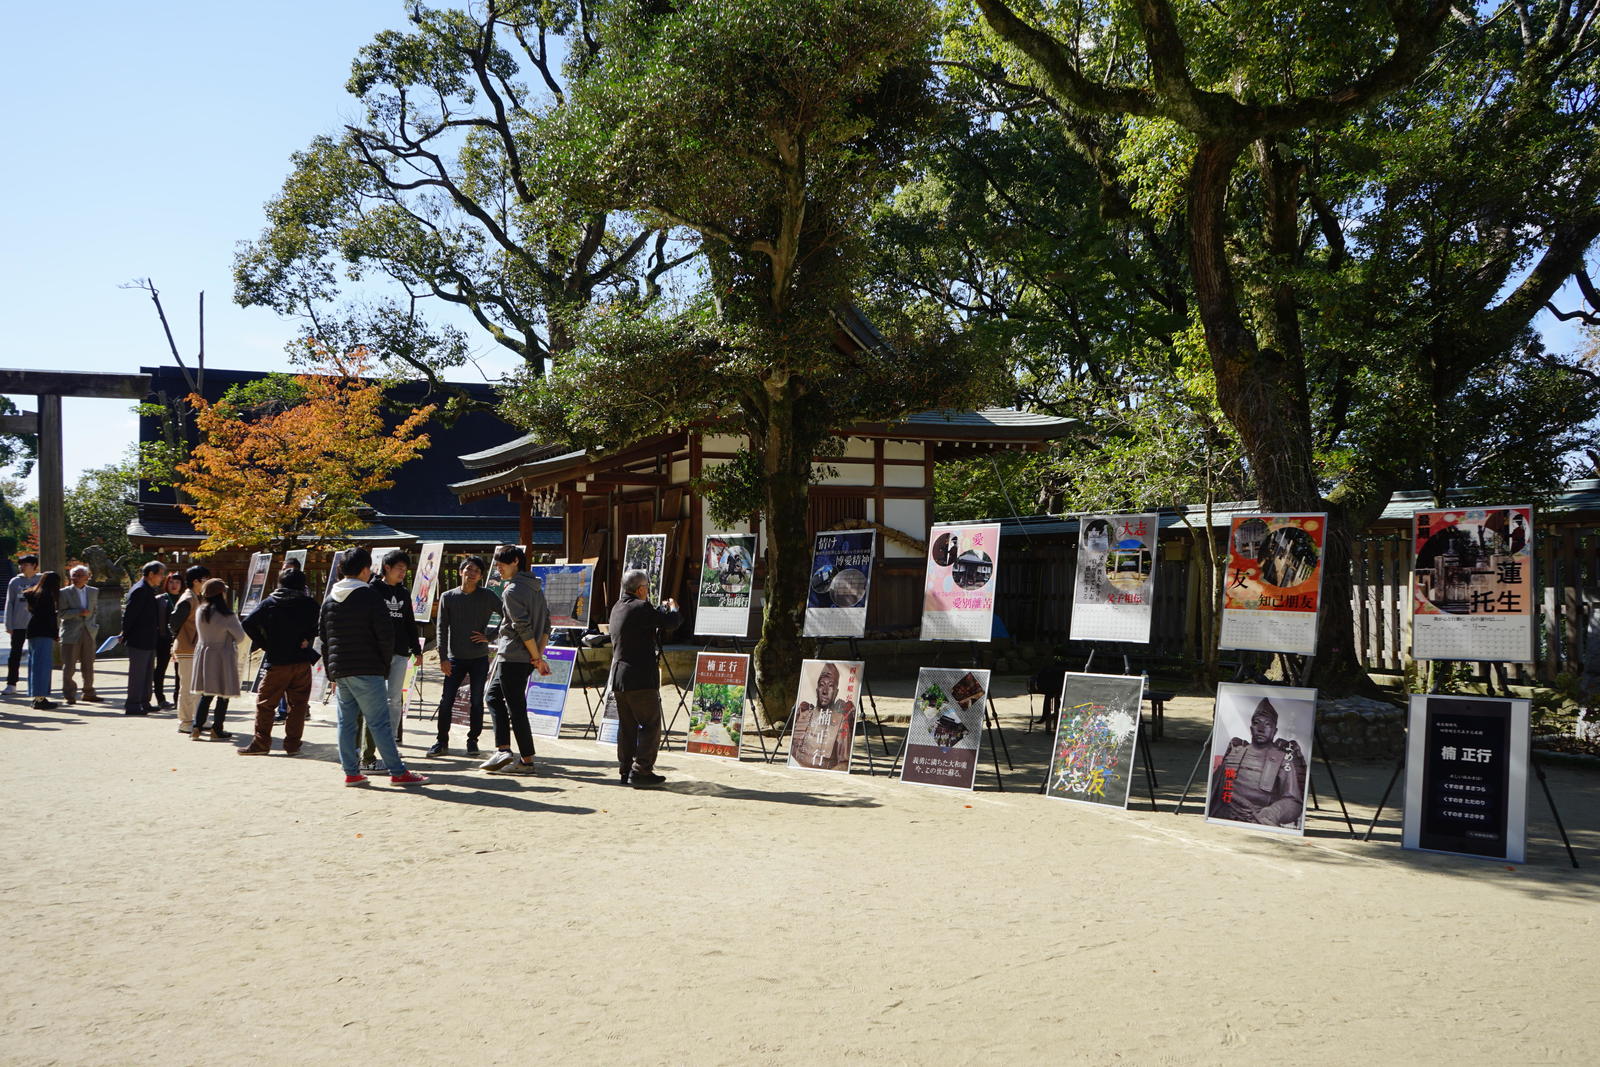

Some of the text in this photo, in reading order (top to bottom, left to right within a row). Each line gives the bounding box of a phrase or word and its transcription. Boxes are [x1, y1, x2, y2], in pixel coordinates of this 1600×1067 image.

[1120, 520, 1148, 536] 大志
[818, 537, 837, 550] 情け
[972, 533, 983, 546] 愛
[835, 555, 871, 566] 博愛精神
[1231, 568, 1250, 589] 友
[1470, 561, 1522, 584] 一蓮
[703, 582, 720, 593] 学び
[952, 598, 992, 609] 愛別離苦
[1107, 593, 1143, 604] 父子相伝
[1258, 594, 1314, 609] 知己朋友
[1470, 590, 1522, 614] 托生
[1461, 748, 1492, 763] 正行
